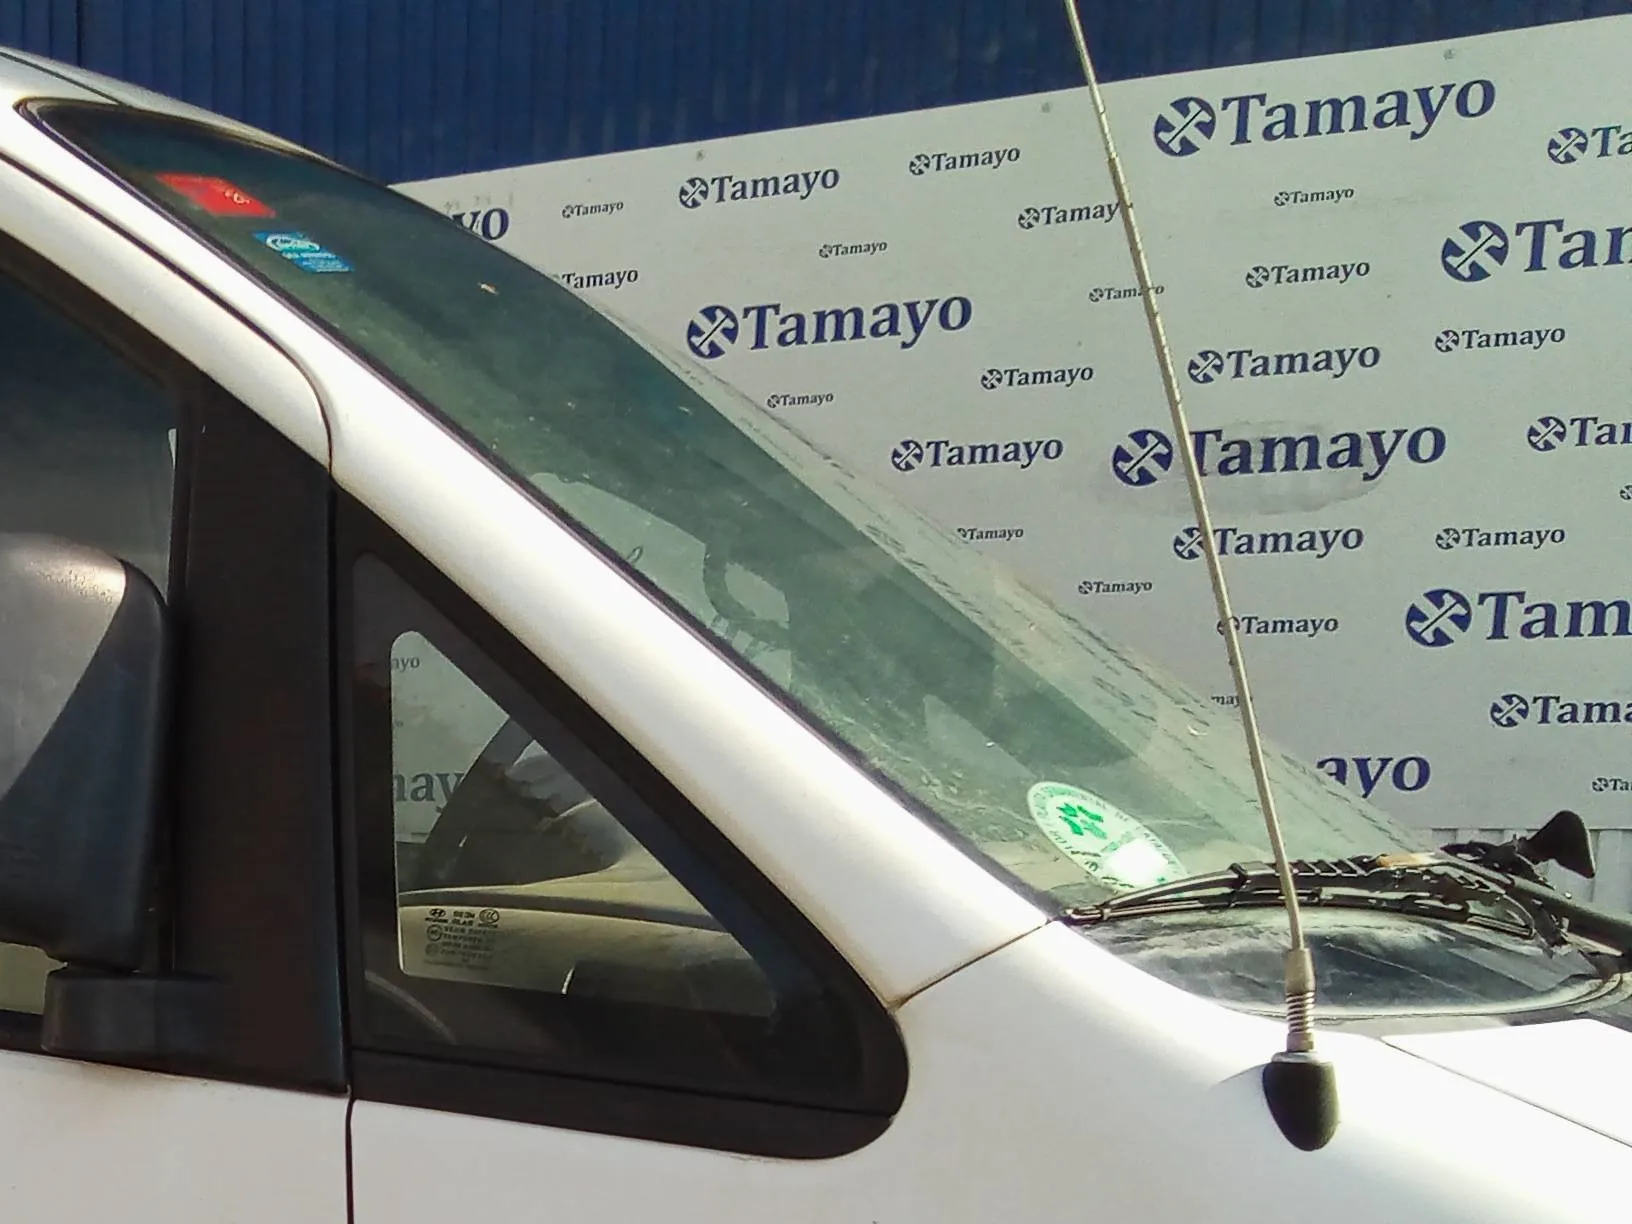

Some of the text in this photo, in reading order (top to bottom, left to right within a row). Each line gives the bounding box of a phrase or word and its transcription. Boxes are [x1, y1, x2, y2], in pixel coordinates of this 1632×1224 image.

[1221, 79, 1496, 146] Tamayo
[931, 148, 1021, 172] Tamayo
[710, 168, 840, 203] Tamayo
[1290, 188, 1355, 204] Tamayo
[574, 201, 624, 217] Tamayo
[1041, 202, 1123, 224] Tamay
[832, 242, 888, 260] Tamayo
[562, 269, 639, 290] Tamayo
[1271, 262, 1370, 285] Tamayo
[743, 296, 972, 351] Tamayo
[1461, 327, 1566, 350] Tamayo
[1226, 346, 1381, 379] Tamayo
[1004, 366, 1095, 388] Tamayo
[779, 393, 834, 408] Tamayo
[925, 438, 1064, 469] Tamayo
[1189, 426, 1446, 481] Tamayo
[967, 528, 1024, 541] Tamayo
[1215, 527, 1364, 559] Tamayo
[1462, 528, 1566, 550] Tamayo
[1092, 581, 1153, 595] Tamayo
[1477, 590, 1632, 640] Tam
[1241, 616, 1339, 638] Tamayo
